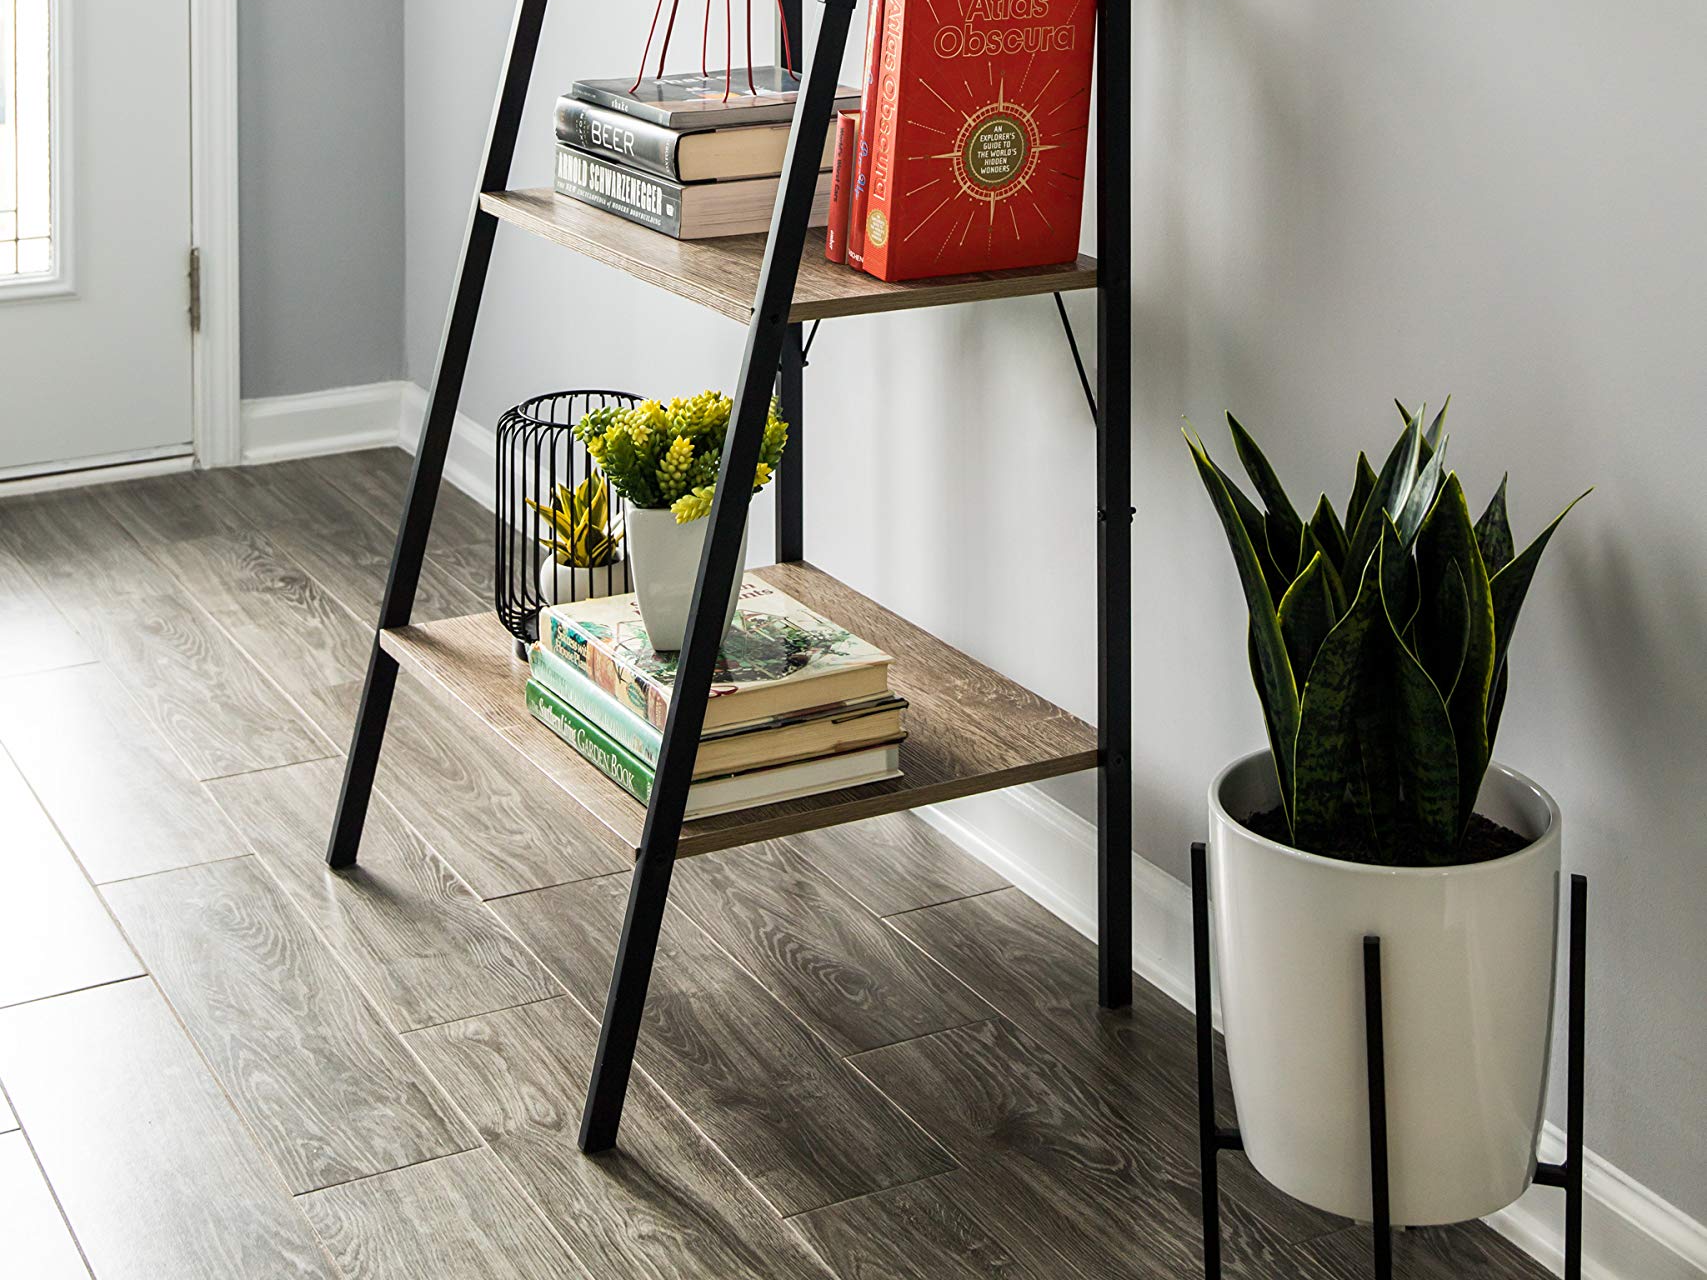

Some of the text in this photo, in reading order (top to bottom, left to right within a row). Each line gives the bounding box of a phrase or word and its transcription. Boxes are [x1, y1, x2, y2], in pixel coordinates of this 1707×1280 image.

[934, 23, 1075, 59] Obscura
[873, 73, 897, 201] Obscura
[980, 132, 1015, 142] EXPLORER'S
[993, 125, 1003, 133] AN
[591, 120, 635, 156] BEER
[983, 142, 1001, 150] GUIDE
[984, 157, 1007, 166] HIDDEN
[990, 148, 1017, 158] WORLD'S
[835, 159, 843, 183] Worst
[980, 165, 1010, 174] WONDERS
[558, 151, 663, 216] ARNOLD SCHWARZENEGGER
[577, 729, 610, 770] GARDEN
[611, 753, 635, 792] BOOK
